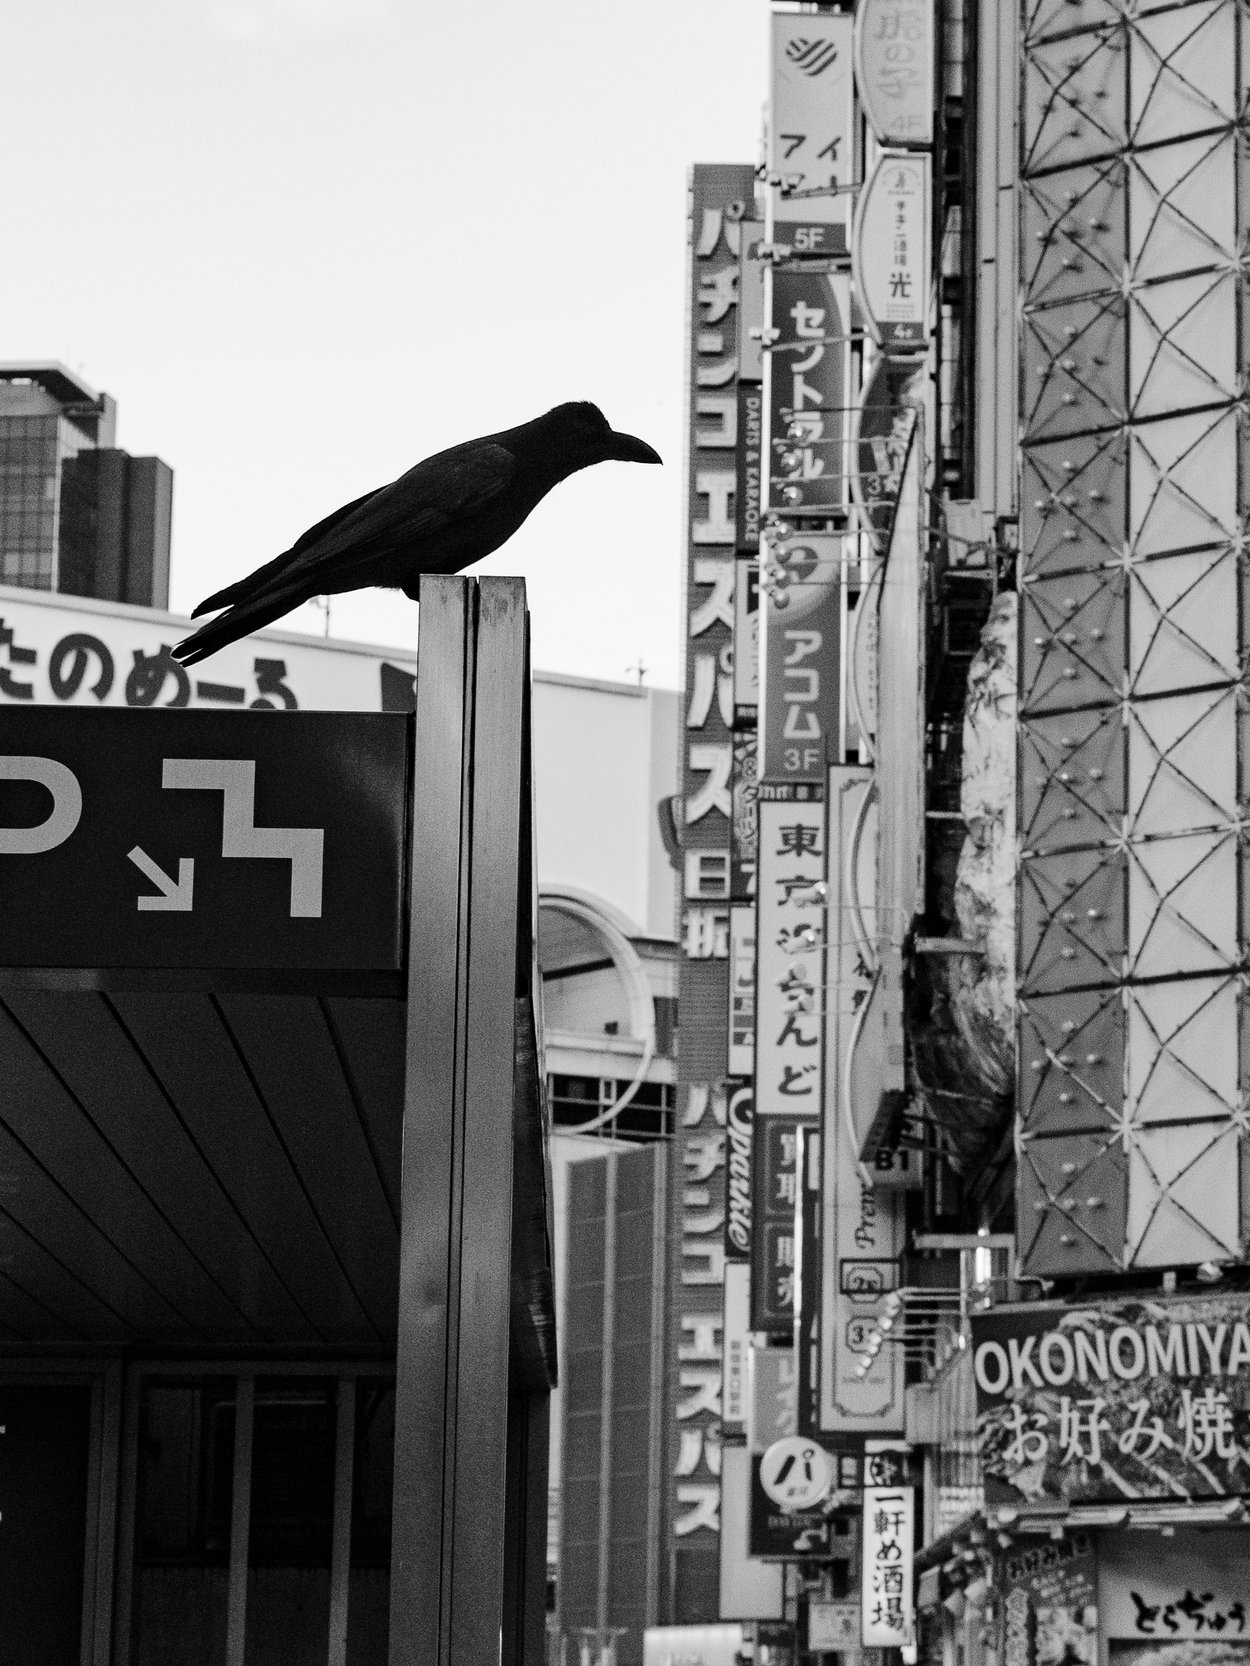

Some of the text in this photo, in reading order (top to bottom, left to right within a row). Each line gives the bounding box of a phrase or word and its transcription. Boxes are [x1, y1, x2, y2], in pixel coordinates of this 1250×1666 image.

[795, 227, 825, 249] 5F
[889, 272, 912, 298] 光
[745, 397, 761, 446] DARTS
[744, 467, 761, 542] KARAOKE
[784, 630, 823, 739] アコム
[784, 749, 820, 772] 3F
[875, 1150, 909, 1170] B1
